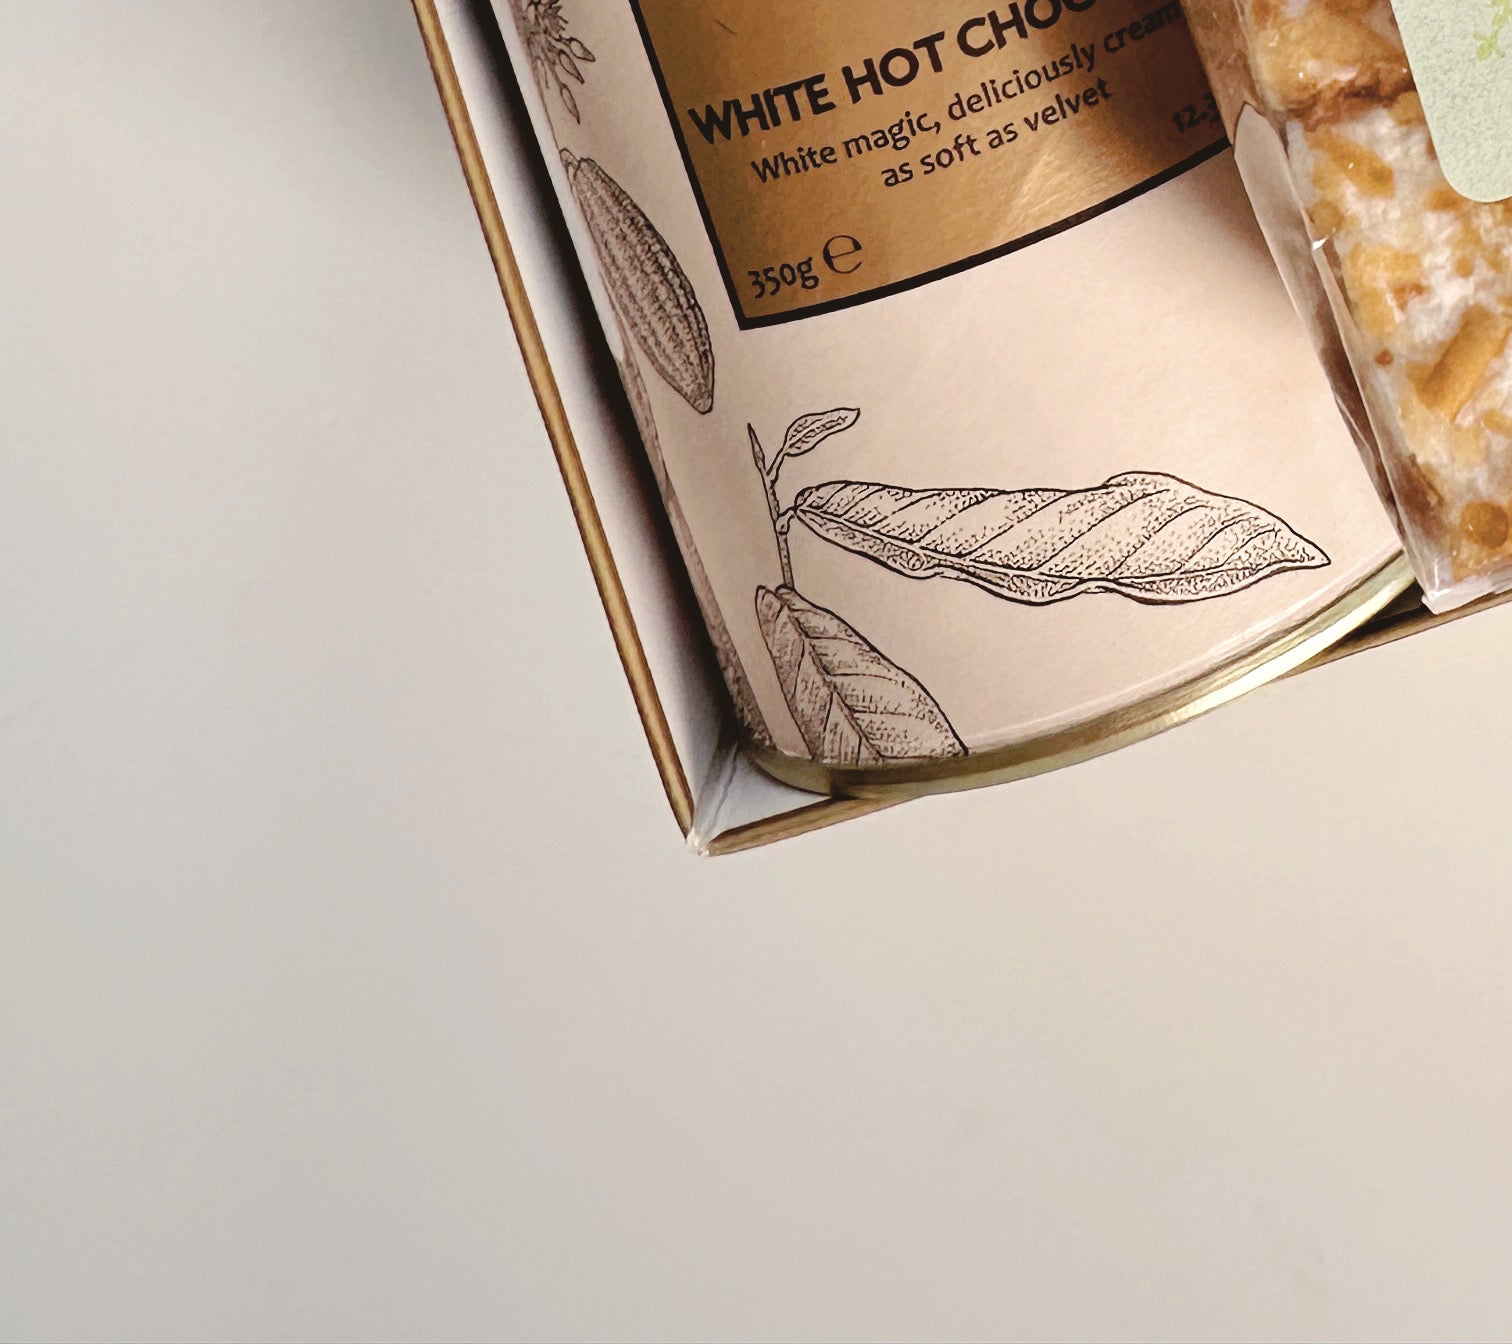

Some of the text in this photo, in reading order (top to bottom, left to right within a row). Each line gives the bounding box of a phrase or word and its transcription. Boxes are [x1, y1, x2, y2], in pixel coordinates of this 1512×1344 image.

[687, 73, 837, 146] WHITE
[842, 32, 946, 105] HOT
[751, 0, 1183, 185] White magic, deliciously cream
[881, 77, 1114, 189] as soft as velvet
[747, 255, 819, 300] 350g
